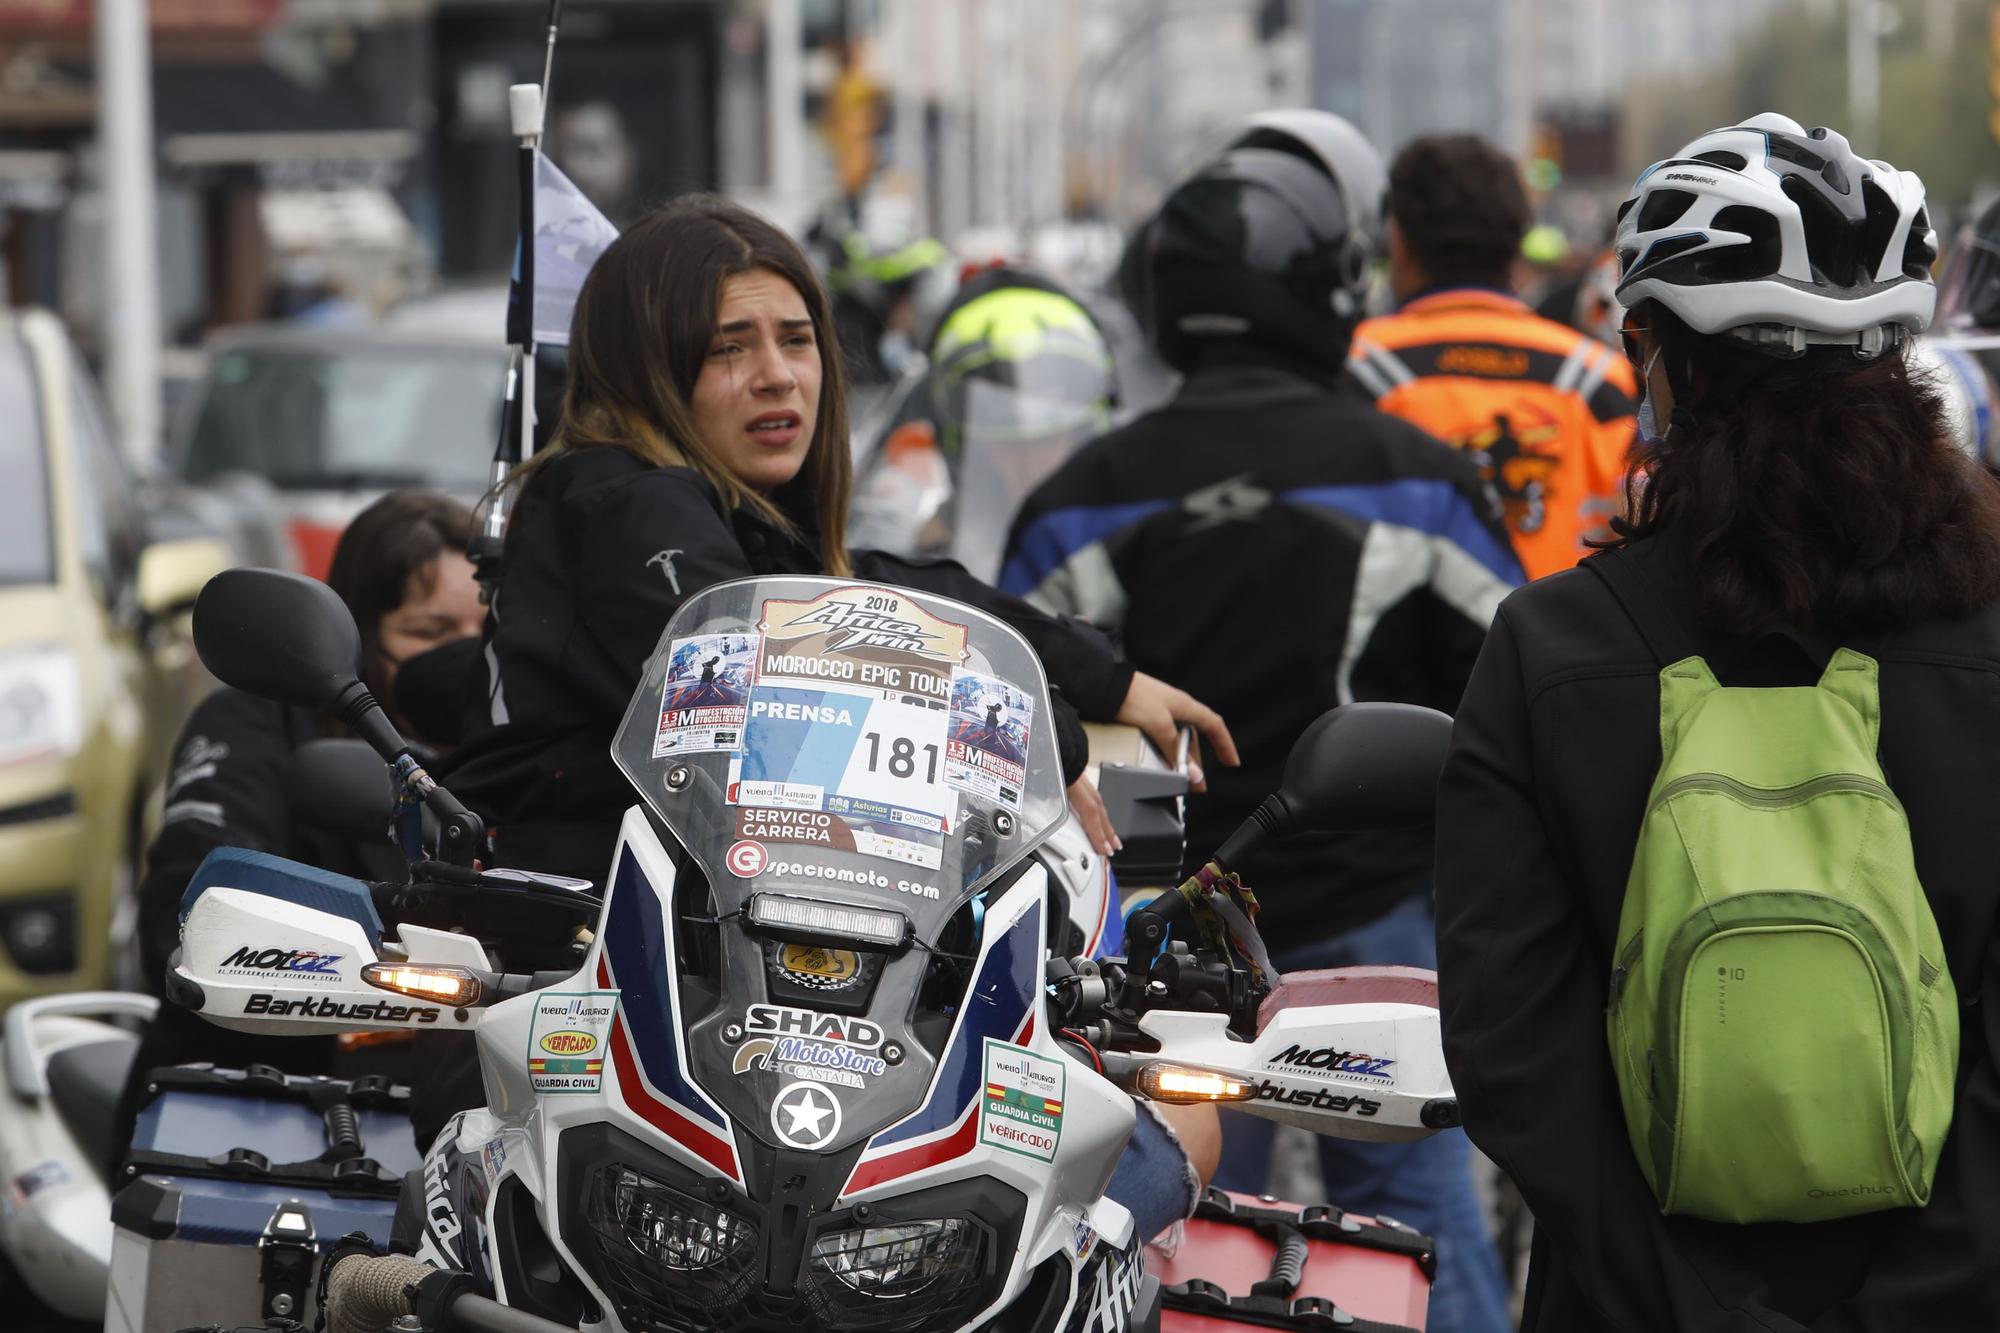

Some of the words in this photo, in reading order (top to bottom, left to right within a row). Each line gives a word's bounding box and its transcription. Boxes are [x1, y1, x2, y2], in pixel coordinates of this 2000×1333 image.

[864, 596, 898, 613] 2018
[782, 600, 944, 639] Africa
[820, 627, 950, 656] Twin
[767, 655, 854, 680] MOROCCO
[908, 671, 951, 697] TOUR
[752, 701, 853, 727] PRENSA
[865, 732, 938, 784] 181
[948, 741, 965, 754] 13
[744, 809, 831, 828] SERVICIO
[853, 801, 888, 814] Asturias
[904, 813, 937, 827] OVIEDO
[742, 824, 831, 843] CARRERA
[776, 964, 857, 991] ASTURIAS
[1730, 967, 1745, 981] 10
[243, 993, 440, 1023] Barkbusters
[749, 1007, 880, 1046] SHAD
[547, 1035, 592, 1052] VERIFICADO
[778, 1038, 886, 1074] MotoStore
[535, 1079, 570, 1088] GUARDIA
[572, 1079, 596, 1088] CIVIL
[795, 1066, 864, 1088] CASTALIA
[990, 1102, 1030, 1121] GUARDIA
[1032, 1113, 1056, 1128] CIVIL
